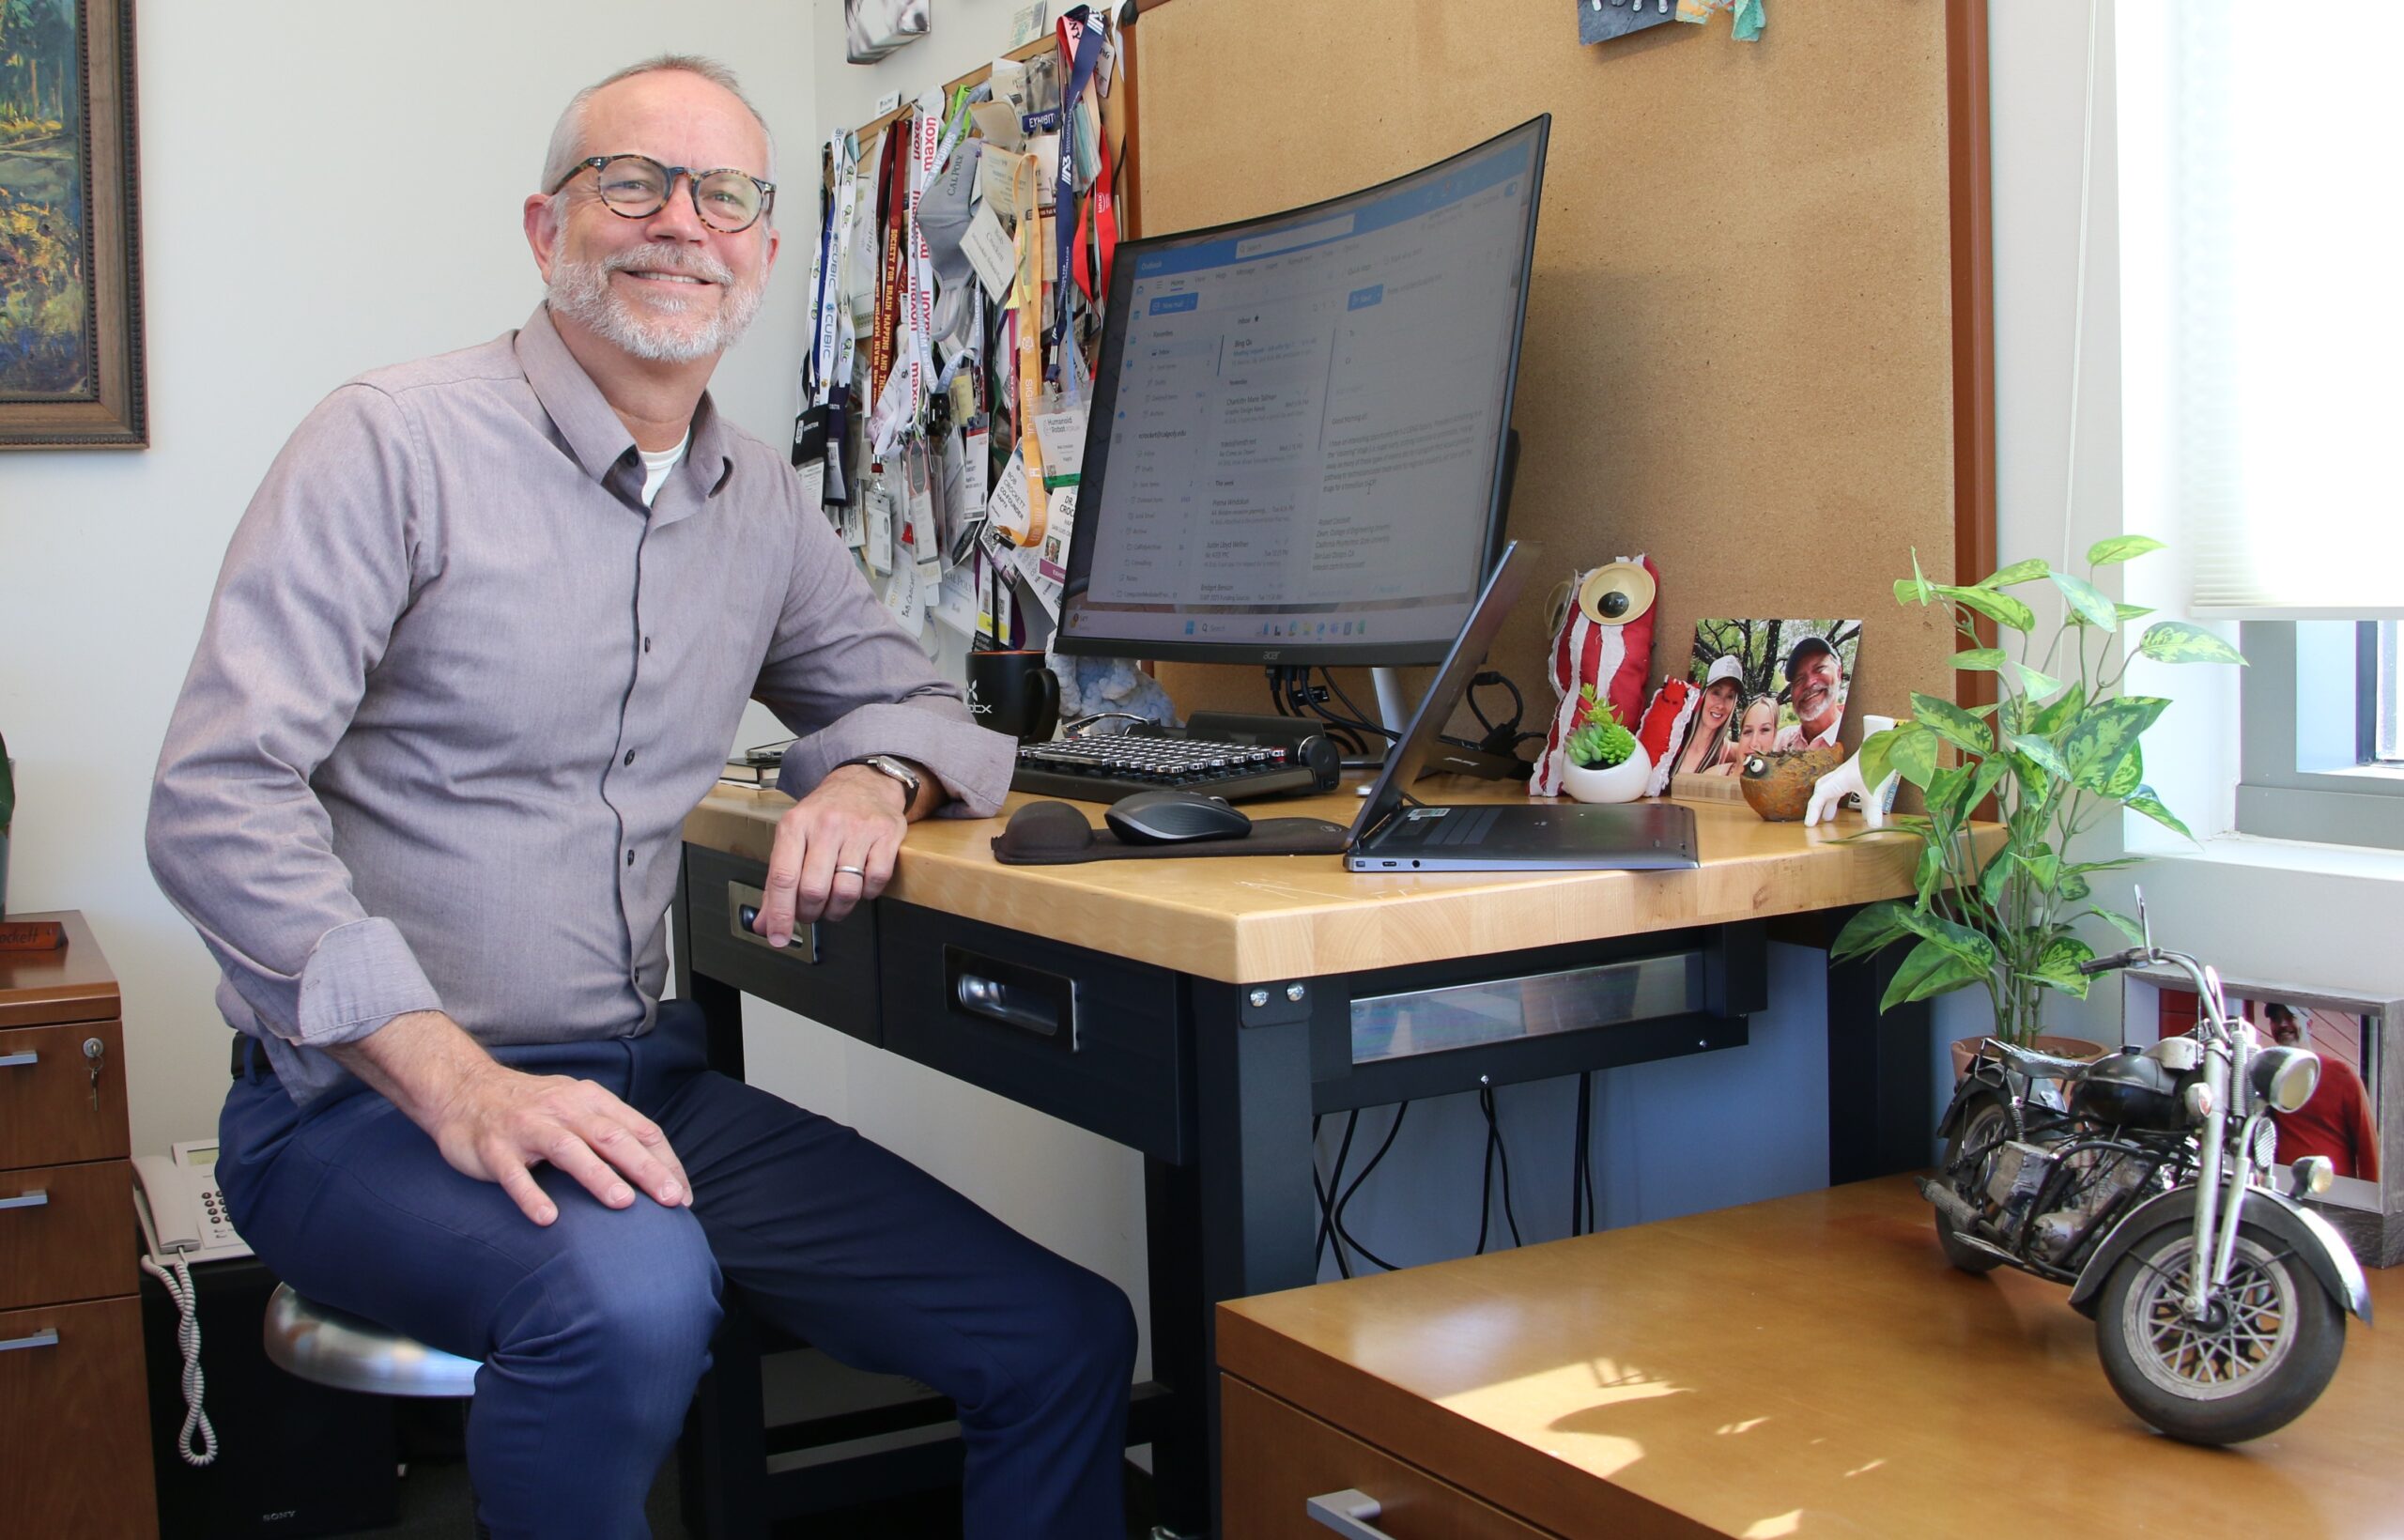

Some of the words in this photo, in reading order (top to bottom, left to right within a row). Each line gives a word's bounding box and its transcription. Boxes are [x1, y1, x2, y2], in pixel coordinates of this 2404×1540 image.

[914, 117, 922, 160] axon
[1029, 113, 1054, 128] EXHIBIT
[924, 116, 937, 172] maxon
[932, 131, 956, 174] SolidCAM
[947, 175, 958, 196] CAL
[953, 154, 963, 176] POLY
[888, 229, 898, 263] SOCIETY
[829, 243, 840, 288] CUBIC
[885, 285, 894, 310] BRAIN
[823, 314, 834, 360] CUBIC
[881, 311, 892, 350] MAPPING
[879, 353, 888, 372] AND
[1059, 503, 1074, 518] CROC
[1263, 651, 1281, 660] acer
[262, 1509, 296, 1521] SONY
